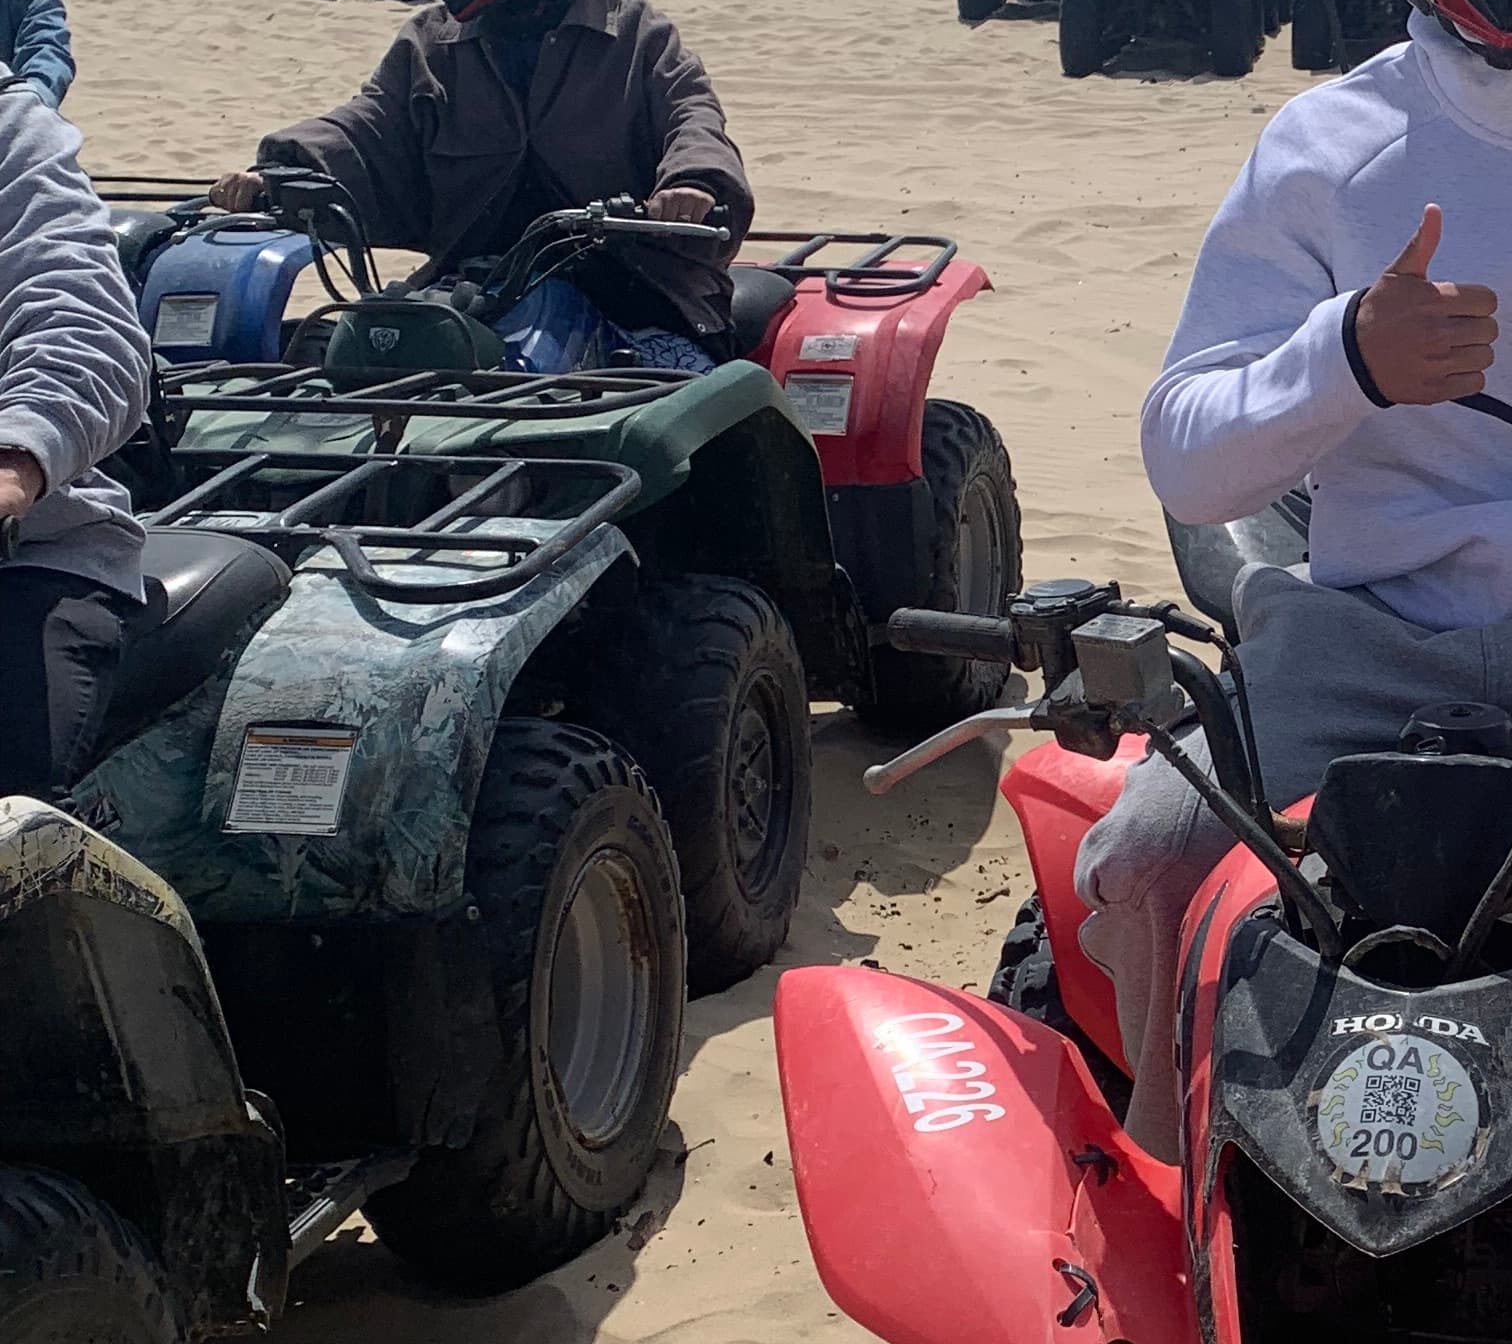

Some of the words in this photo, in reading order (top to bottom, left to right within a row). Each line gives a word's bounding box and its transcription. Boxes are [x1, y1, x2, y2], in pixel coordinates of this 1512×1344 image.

[872, 1012, 1006, 1133] 04226
[1366, 1044, 1425, 1075] QA
[1350, 1128, 1418, 1160] 200
